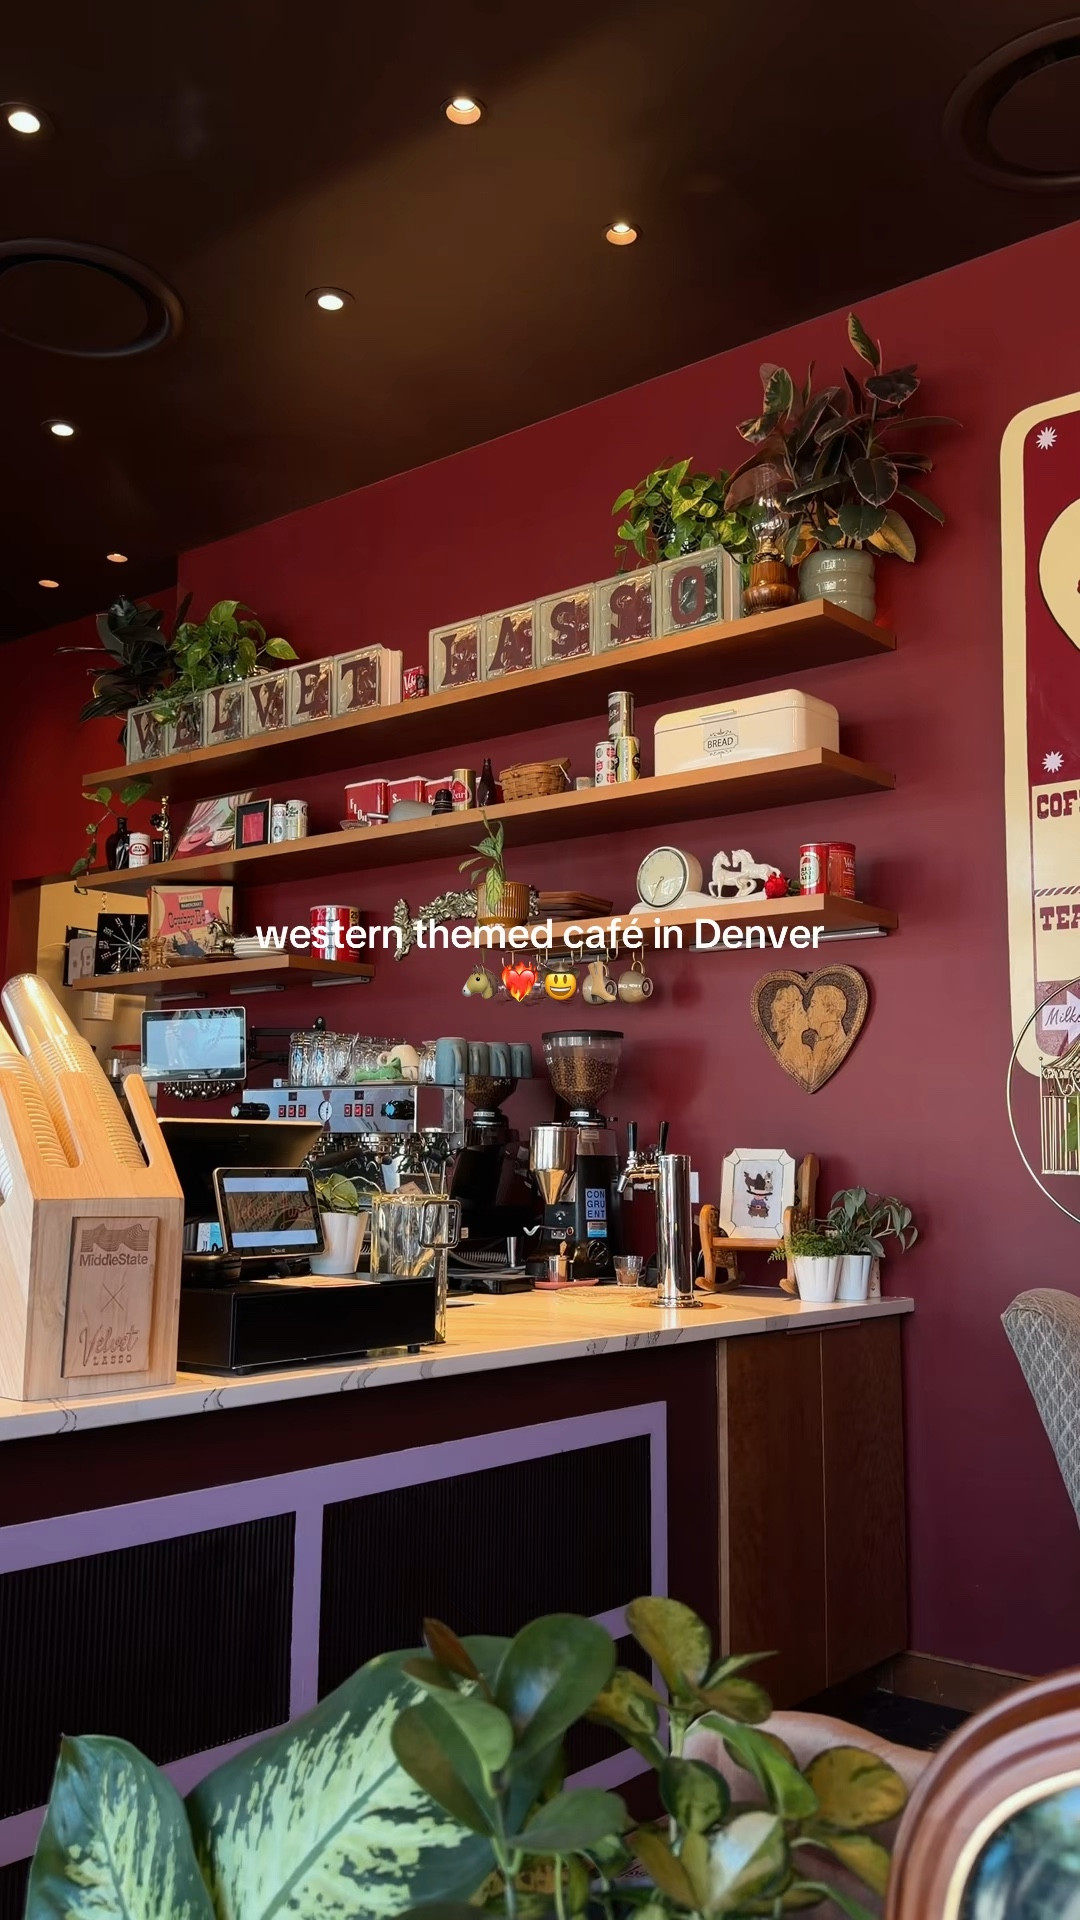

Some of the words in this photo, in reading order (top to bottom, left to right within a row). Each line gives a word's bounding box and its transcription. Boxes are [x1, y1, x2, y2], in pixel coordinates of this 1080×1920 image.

[131, 656, 378, 758] VELVET
[440, 565, 706, 687] LASSO
[707, 736, 734, 749] BREAD
[1037, 790, 1080, 819] COF
[586, 1190, 605, 1199] CON
[586, 1200, 605, 1209] GRU
[587, 1210, 606, 1218] ENT
[79, 1252, 149, 1267] MiddleState
[79, 1324, 139, 1367] Velvet
[93, 1354, 132, 1366] LASSO
